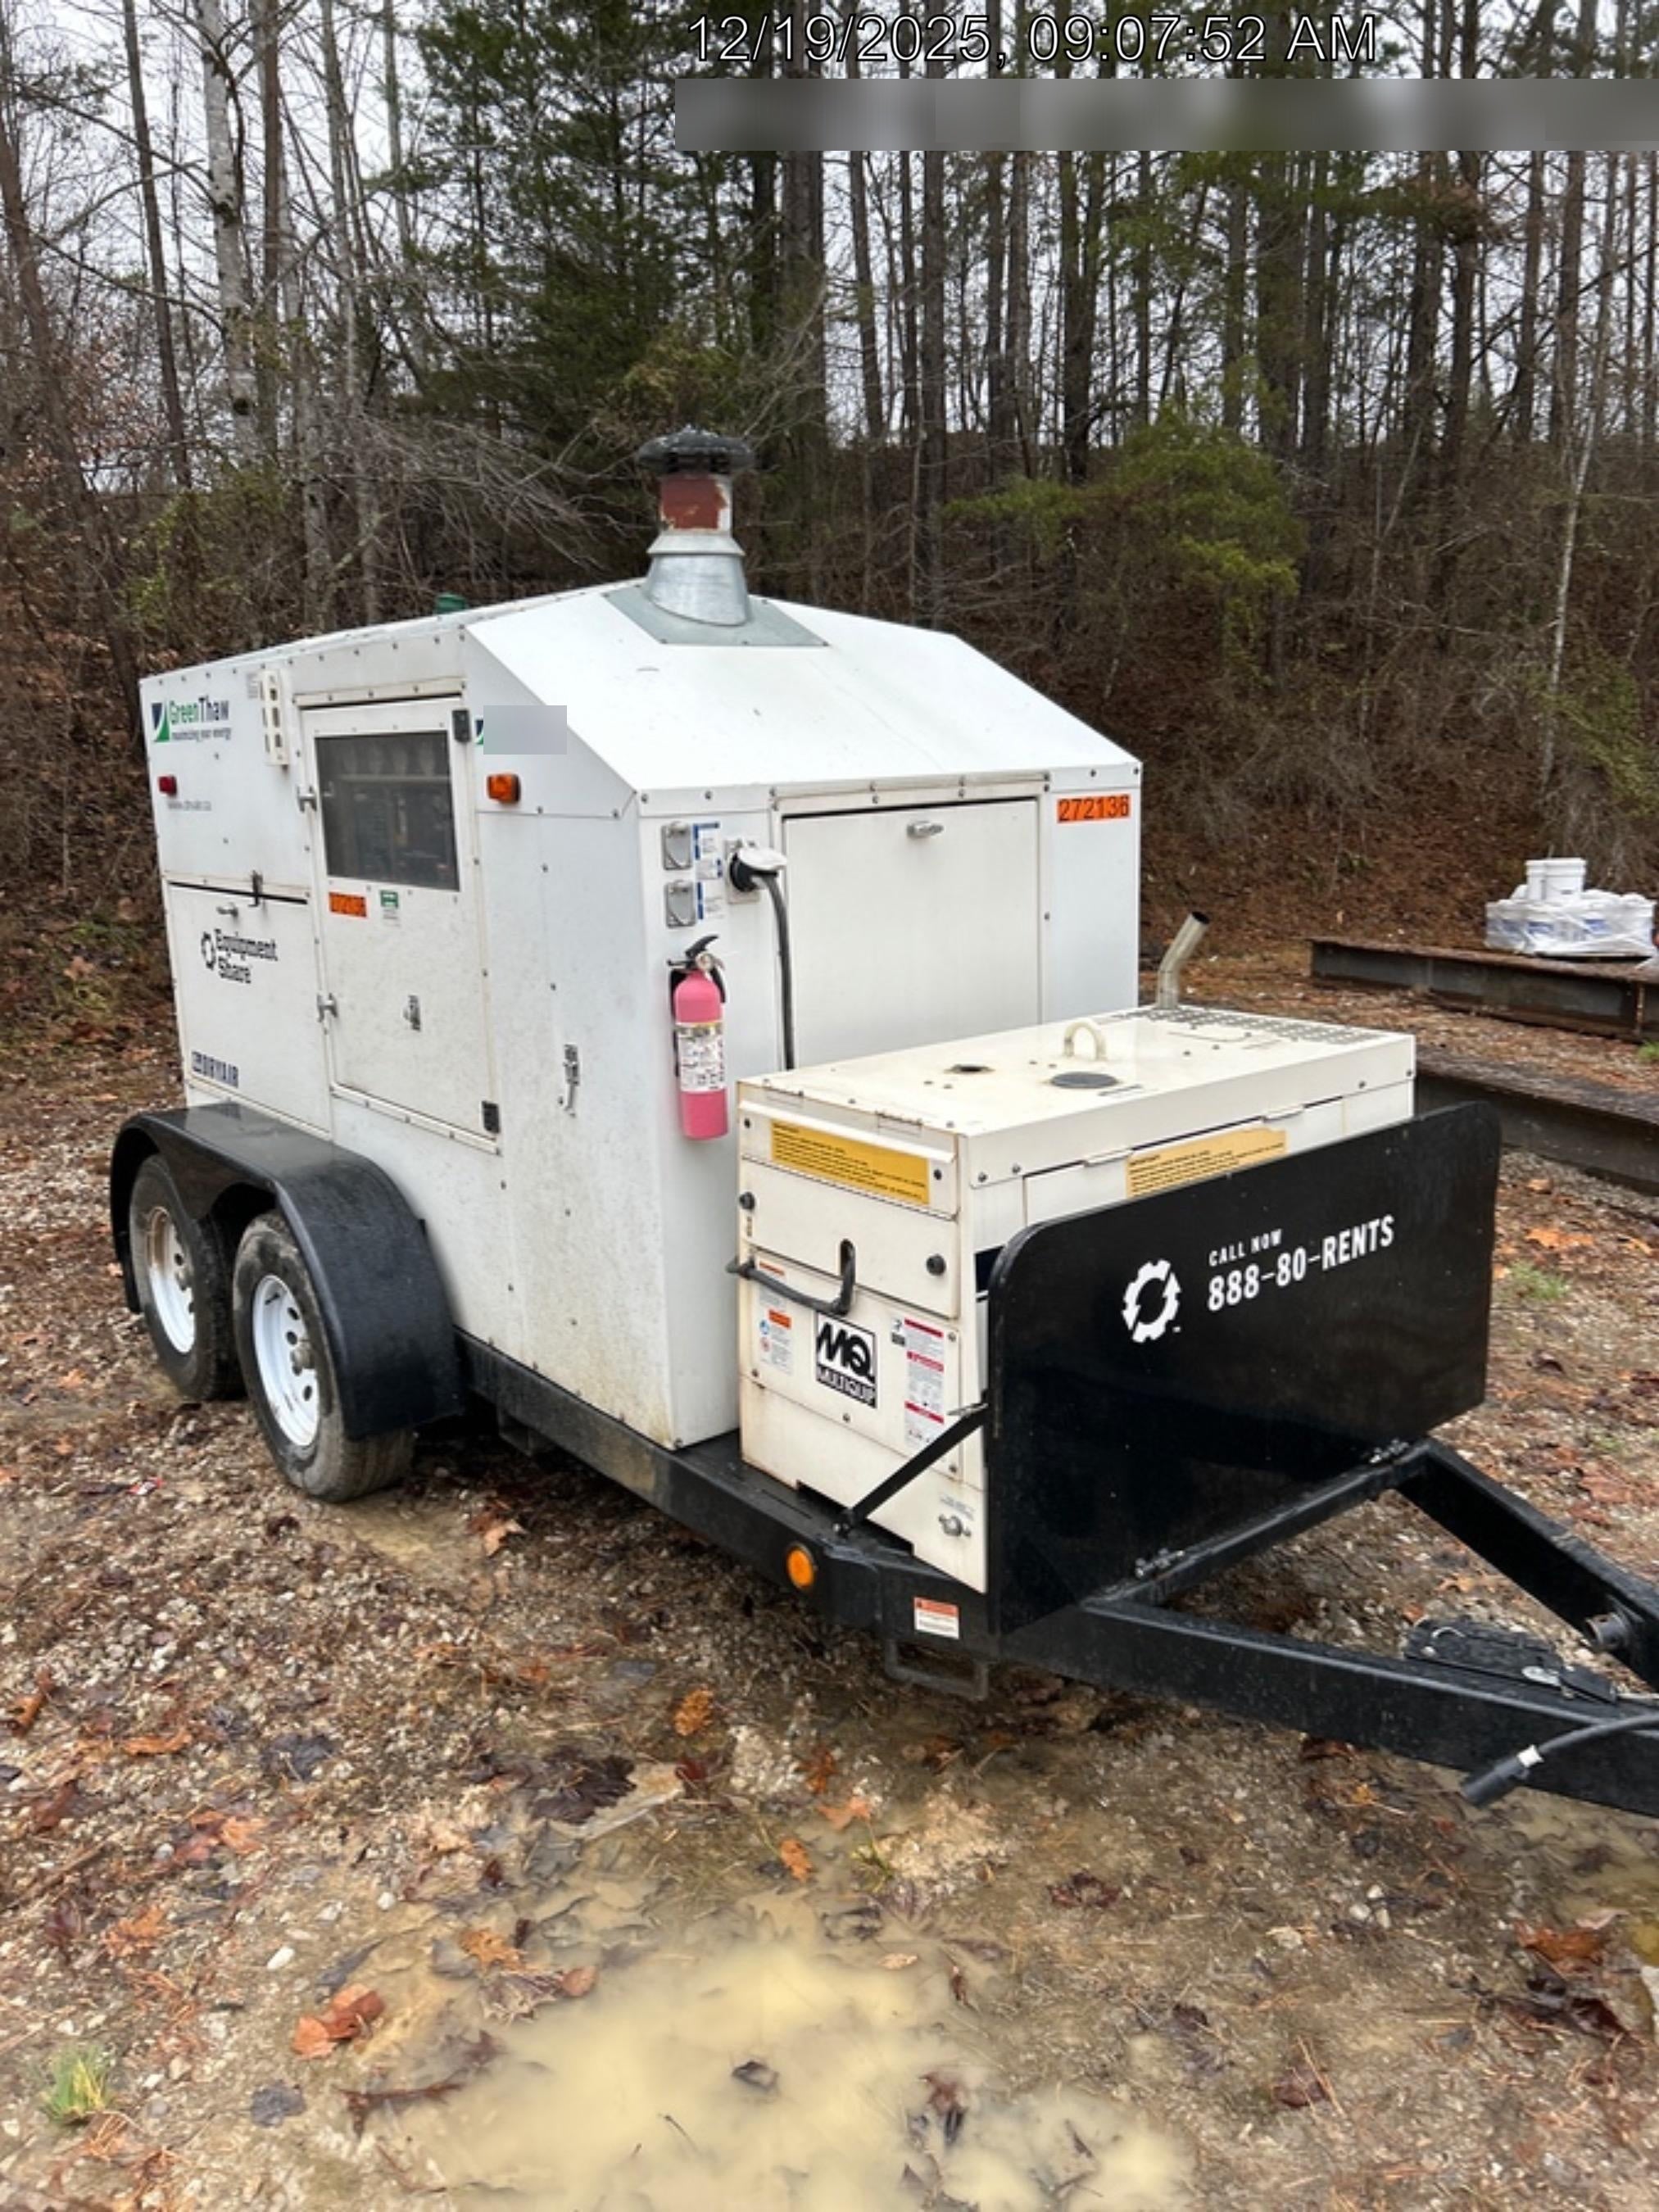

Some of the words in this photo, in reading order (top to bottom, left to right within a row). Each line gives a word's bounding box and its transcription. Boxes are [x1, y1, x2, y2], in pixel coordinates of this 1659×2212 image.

[215, 927, 279, 962] Equipment
[218, 956, 252, 984] Share
[1208, 1241, 1245, 1267] CALL
[1250, 1229, 1282, 1253] NOW
[1208, 1214, 1394, 1312] 888-80-RENTS
[817, 1321, 875, 1386] MQ
